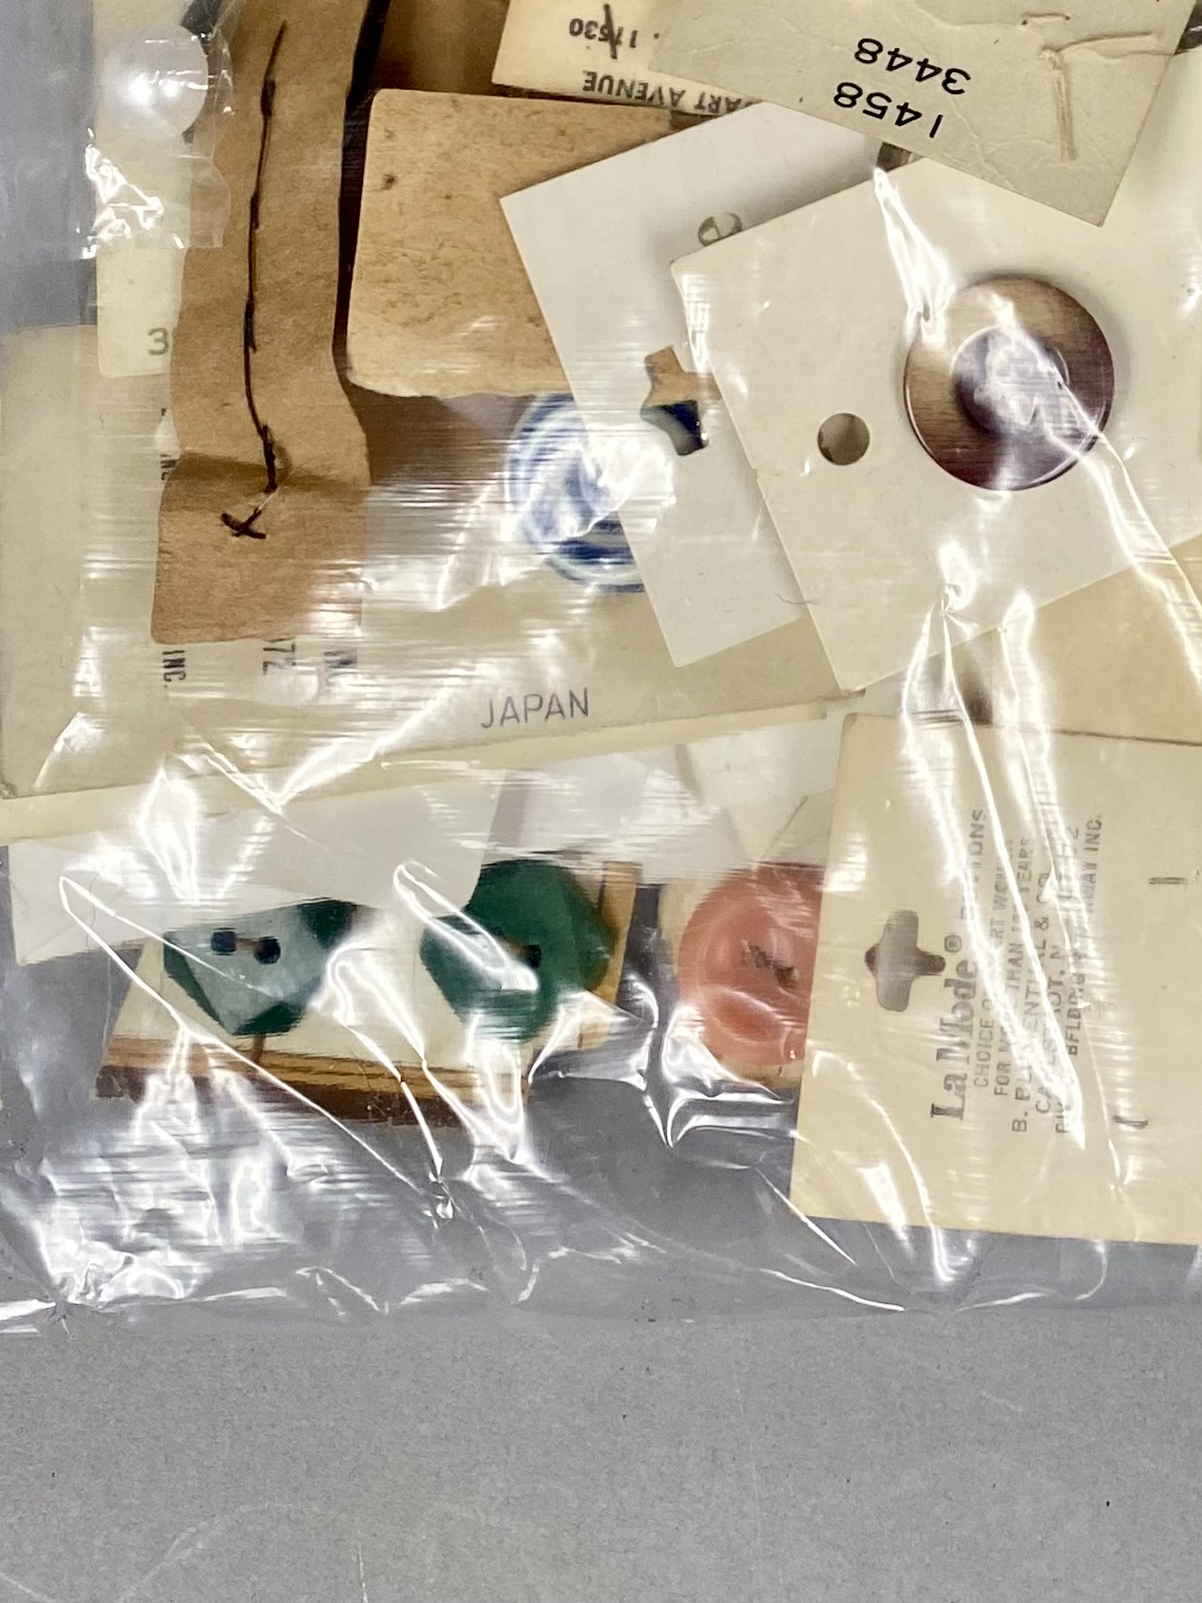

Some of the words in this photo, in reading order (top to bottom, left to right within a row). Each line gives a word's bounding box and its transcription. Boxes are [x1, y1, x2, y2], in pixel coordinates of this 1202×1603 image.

[581, 70, 686, 106] AVENUE
[853, 38, 970, 95] 3448
[694, 92, 752, 113] ART
[835, 85, 943, 138] 1458
[482, 687, 588, 727] JAPAN
[975, 1018, 992, 1087] CHOICE
